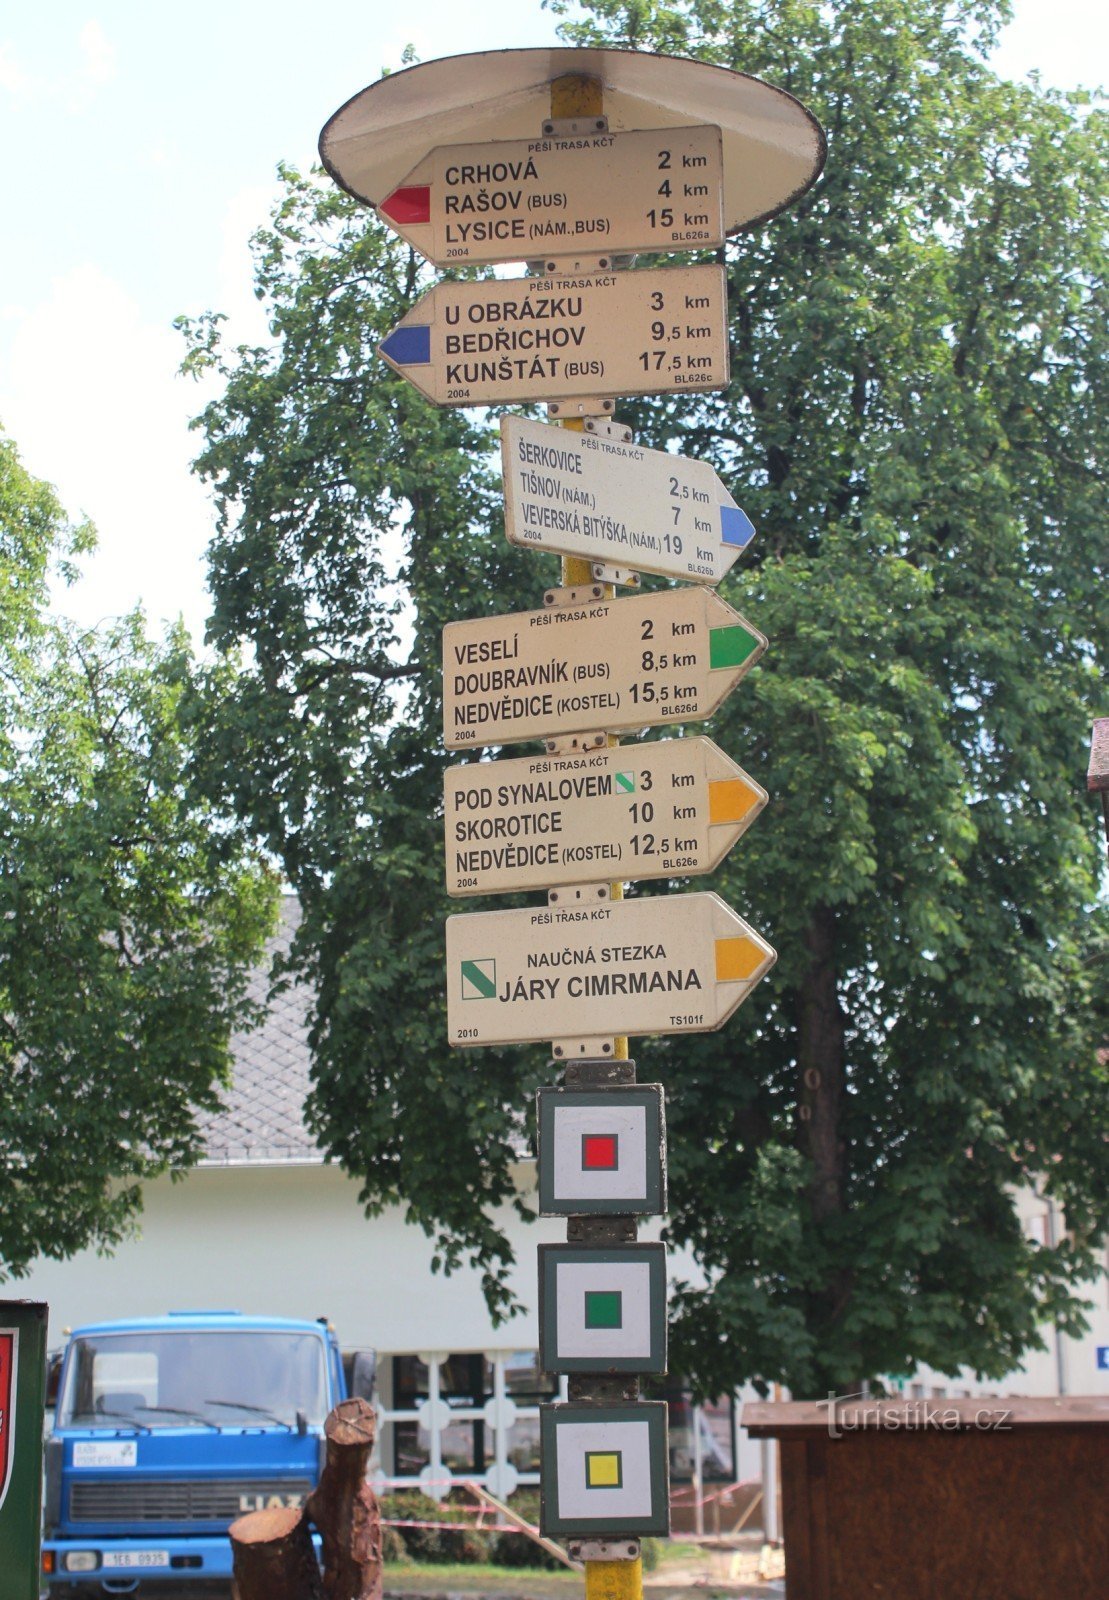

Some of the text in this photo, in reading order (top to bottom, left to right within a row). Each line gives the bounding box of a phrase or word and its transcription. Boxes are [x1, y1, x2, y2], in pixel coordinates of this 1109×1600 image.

[528, 137, 615, 152] PĚŠÍ TRASA KČT
[445, 151, 707, 185] CRHOVÁ 2 km
[445, 180, 708, 214] RAŠOV (BUS) 4 km
[446, 220, 525, 243] LYSICE
[646, 209, 674, 228] 15
[684, 213, 708, 226] km
[671, 231, 709, 241] BL626a
[446, 248, 469, 258] 2004
[529, 277, 616, 292] PĚŠÍ TRASA KČT
[445, 292, 709, 324] U OBRÁZKU 3 km
[446, 322, 711, 354] BEDŘICHOV 9,5 km
[446, 351, 712, 384] KUNŠTÁT (BUS) 17,5 km
[674, 373, 712, 384] BL626c
[447, 389, 470, 399] 2004
[581, 439, 644, 461] PĚŠÍ TRASA KČT
[519, 437, 709, 503] ŠERKOVICE 2,5 km
[520, 470, 711, 533] TIŠNOV (NÁM.) 7 km
[522, 503, 713, 562] VEVERSKÁ BITÝŠKA (NÁM.) 19 km
[524, 530, 542, 541] 2004
[688, 564, 714, 576] BL626b
[530, 608, 609, 627] PĚŠÍ TRASA KČT
[455, 620, 695, 665] VESELÍ 2 km
[455, 651, 696, 696] DOUBRAVNÍK (BUS) 8,5 km
[455, 682, 697, 726] NEDVĚDICE (KOSTEL) 15,5 km
[661, 704, 697, 716] BL626d
[455, 730, 476, 741] 2004
[530, 756, 609, 774] PĚŠÍ TRASA KČT
[455, 770, 695, 812] POD SYNALOVEM 3 km
[455, 803, 696, 842] SKOROTICE 10 km
[456, 834, 697, 873] NEDVĚDICE (KOSTEL) 12,5 km
[663, 858, 698, 869] BL626e
[457, 878, 478, 887] 2004
[531, 909, 611, 925] PĚŠÍ TRASA KČT
[527, 944, 666, 968] NAUČNÁ STEZKA
[499, 969, 702, 1003] JÁRY CIMRMANA
[670, 1015, 703, 1025] TS101f
[457, 1029, 478, 1038] 2010
